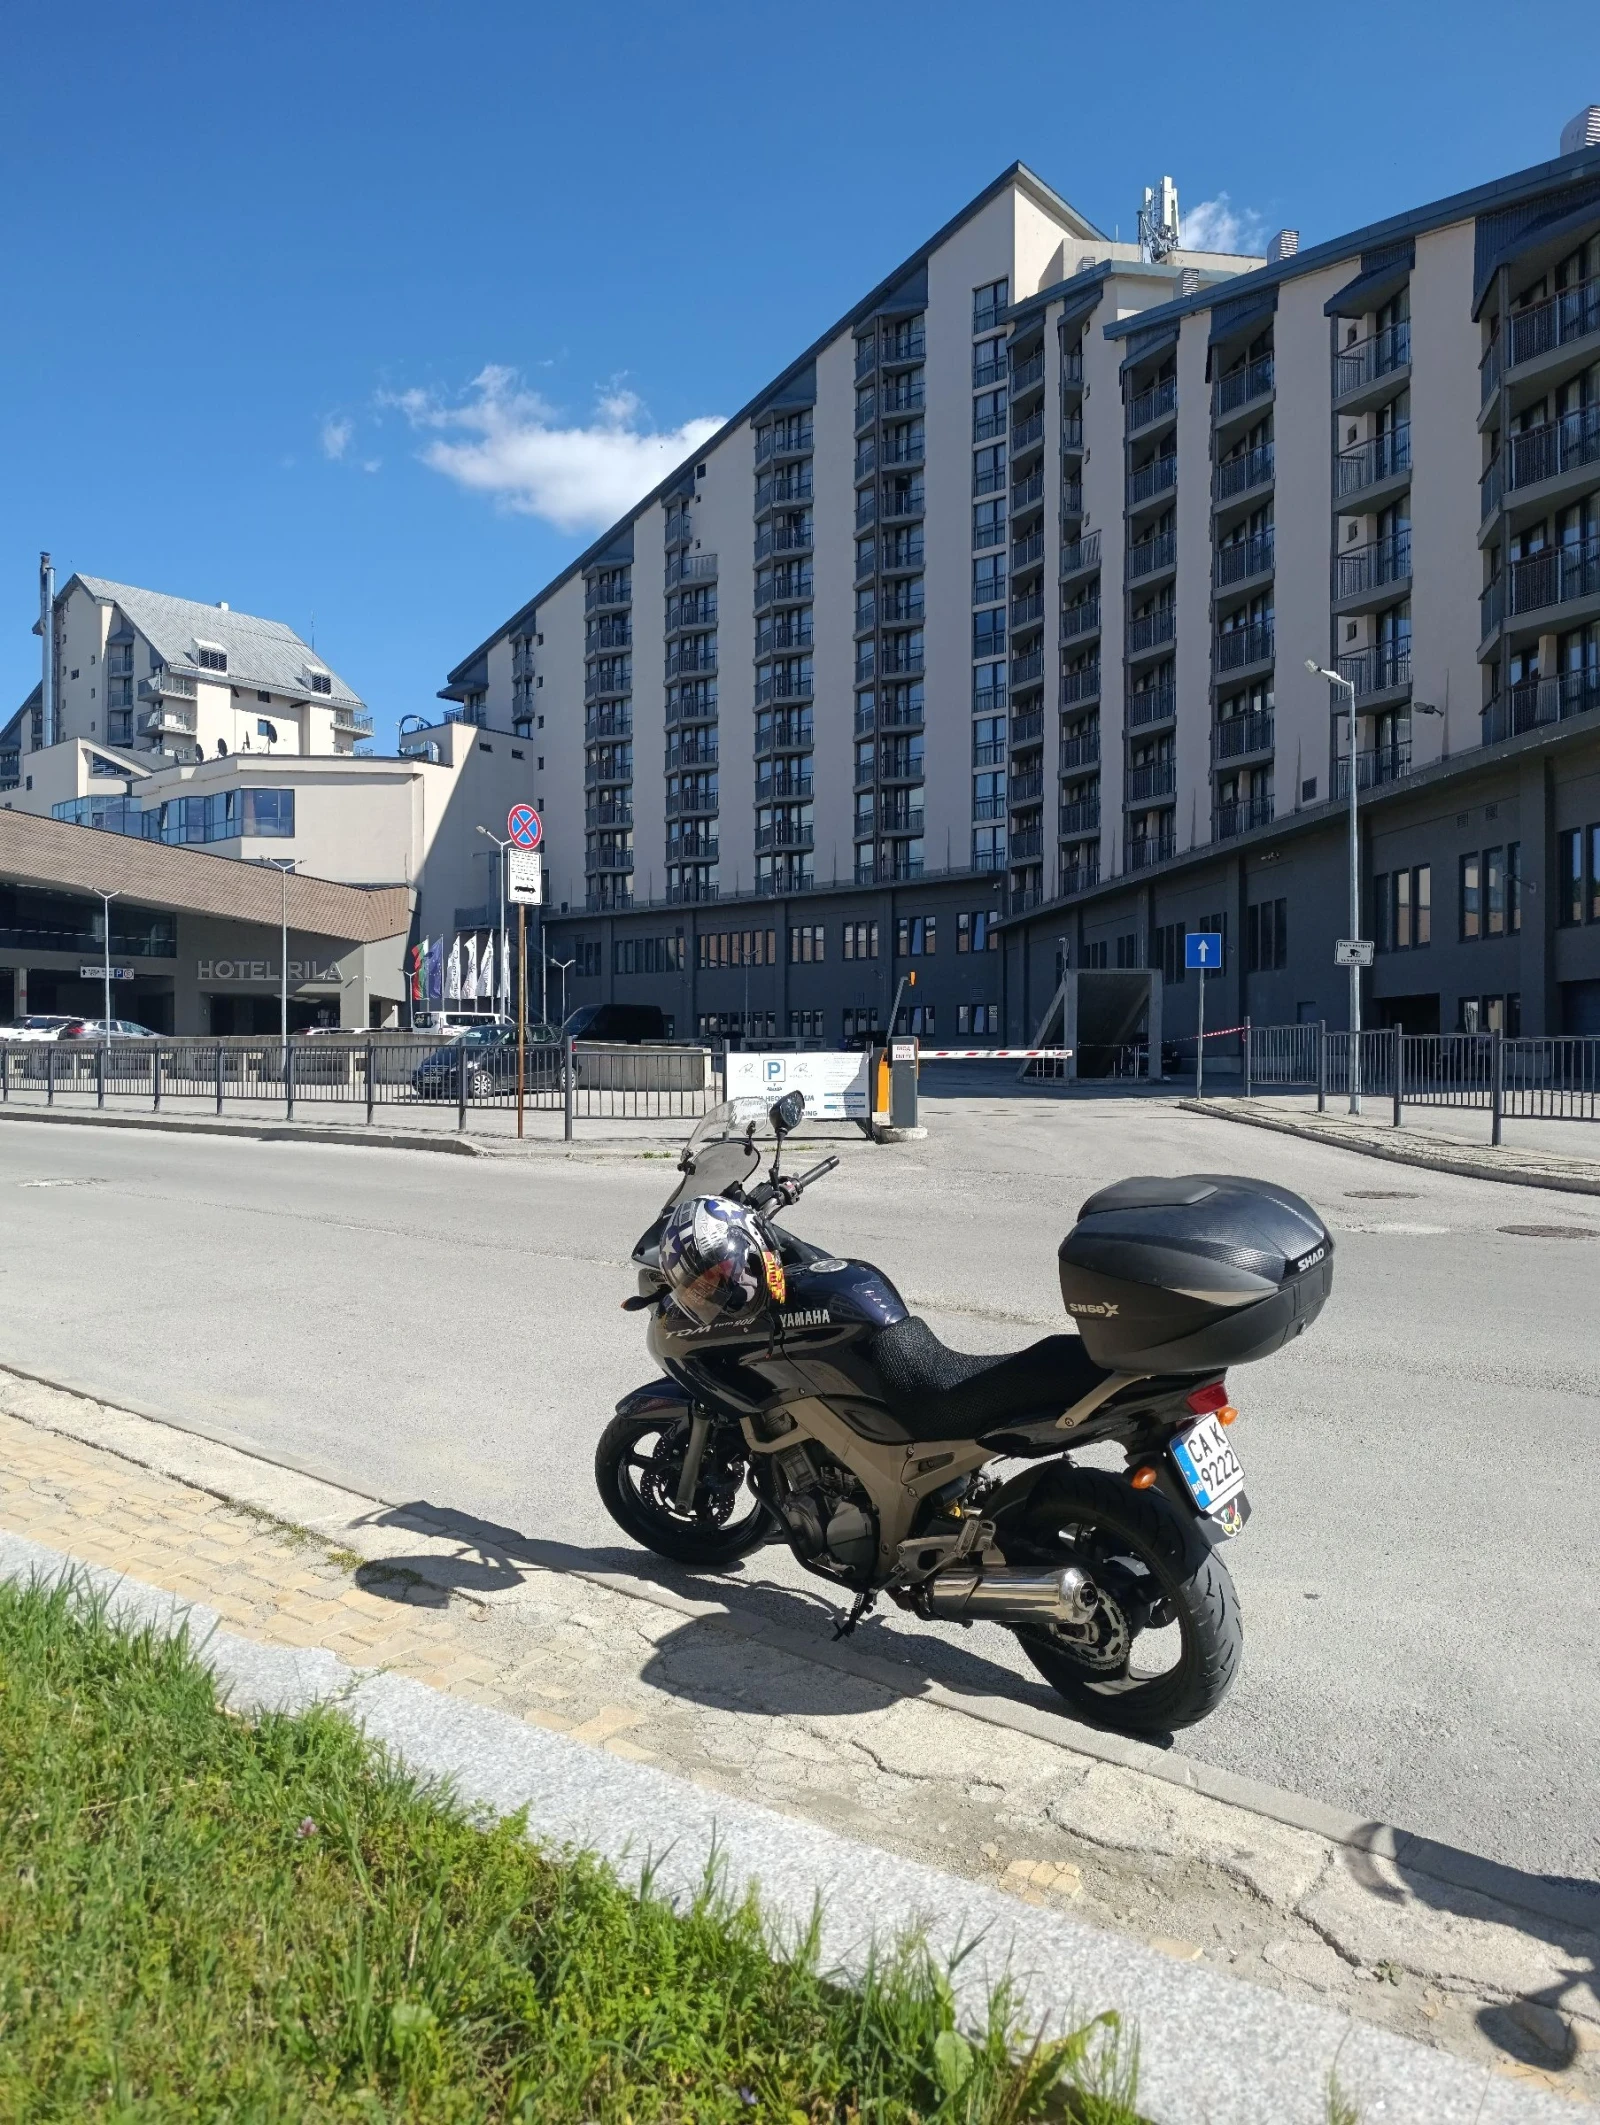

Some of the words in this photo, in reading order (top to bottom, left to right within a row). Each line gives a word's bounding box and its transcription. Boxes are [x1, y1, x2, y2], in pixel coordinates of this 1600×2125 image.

[197, 960, 280, 980] HOTEL
[287, 960, 344, 980] RILA
[767, 1062, 781, 1080] P
[1297, 1247, 1325, 1272] SHAD
[665, 1325, 712, 1340] TDM
[733, 1317, 756, 1327] 900
[779, 1308, 831, 1328] YAMAHA
[1188, 1433, 1213, 1463] CA
[1209, 1421, 1226, 1447] K
[1201, 1449, 1240, 1491] 9222
[1192, 1480, 1204, 1495] BG
